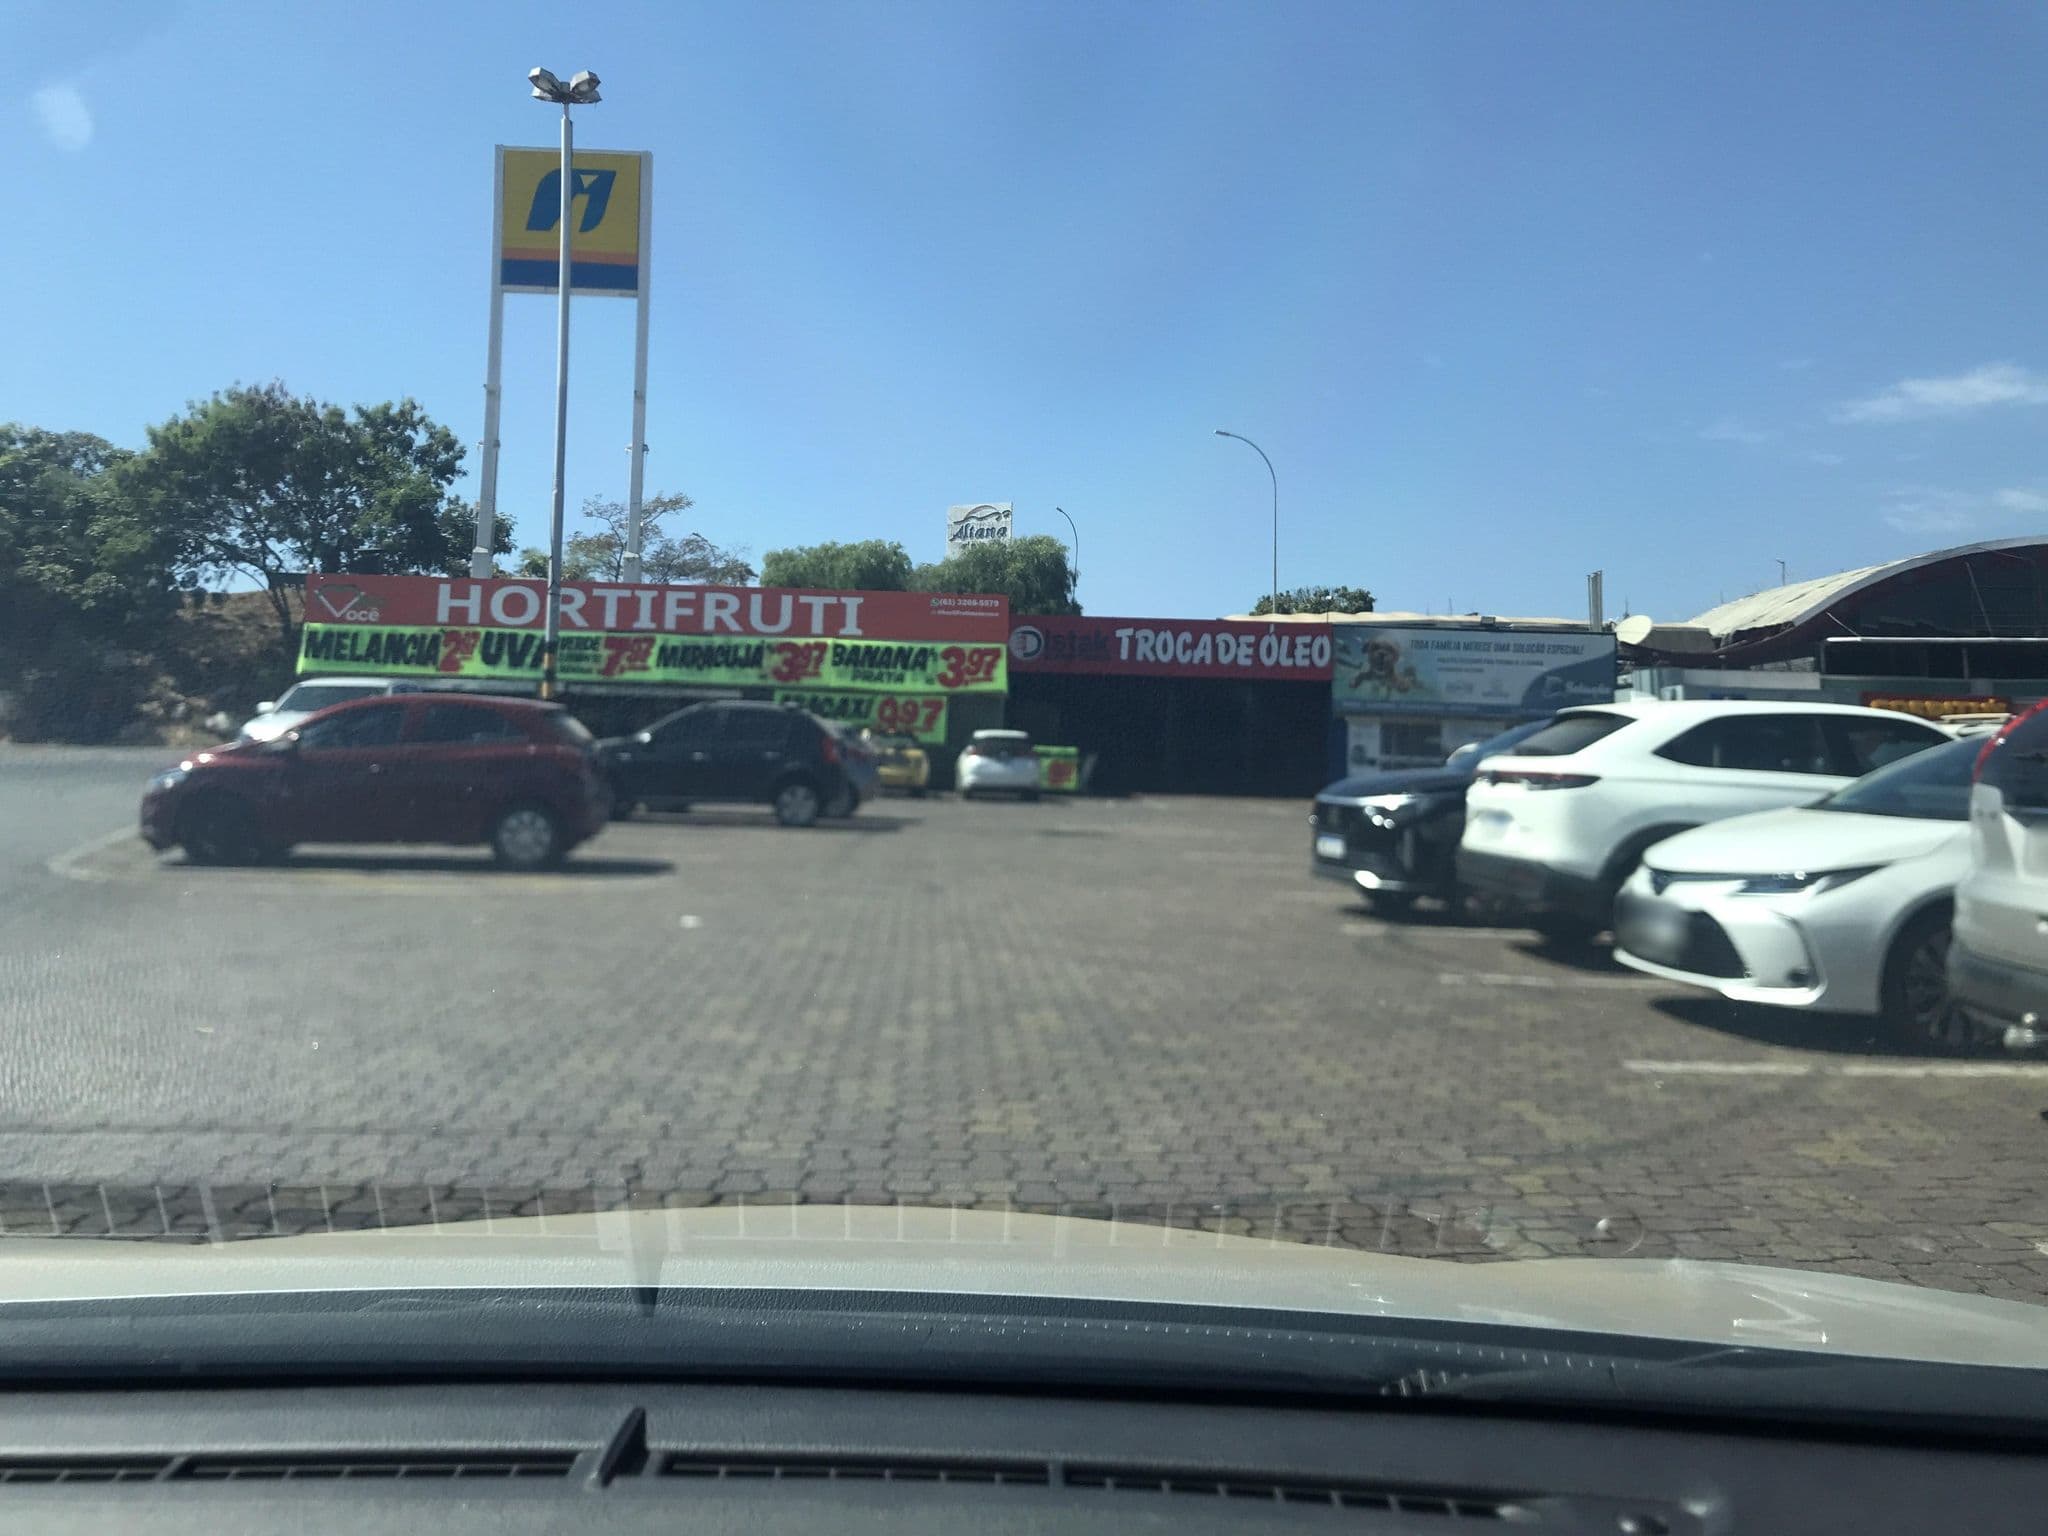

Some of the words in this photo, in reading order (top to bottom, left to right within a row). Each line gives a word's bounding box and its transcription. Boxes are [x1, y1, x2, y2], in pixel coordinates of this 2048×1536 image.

[437, 583, 864, 637] HORTIFRUTI
[304, 629, 442, 667] MELANCIA
[831, 643, 929, 671] BANANA
[1115, 627, 1212, 664] TROCA
[1215, 631, 1255, 666] DE
[1259, 623, 1331, 667] ÓLEO
